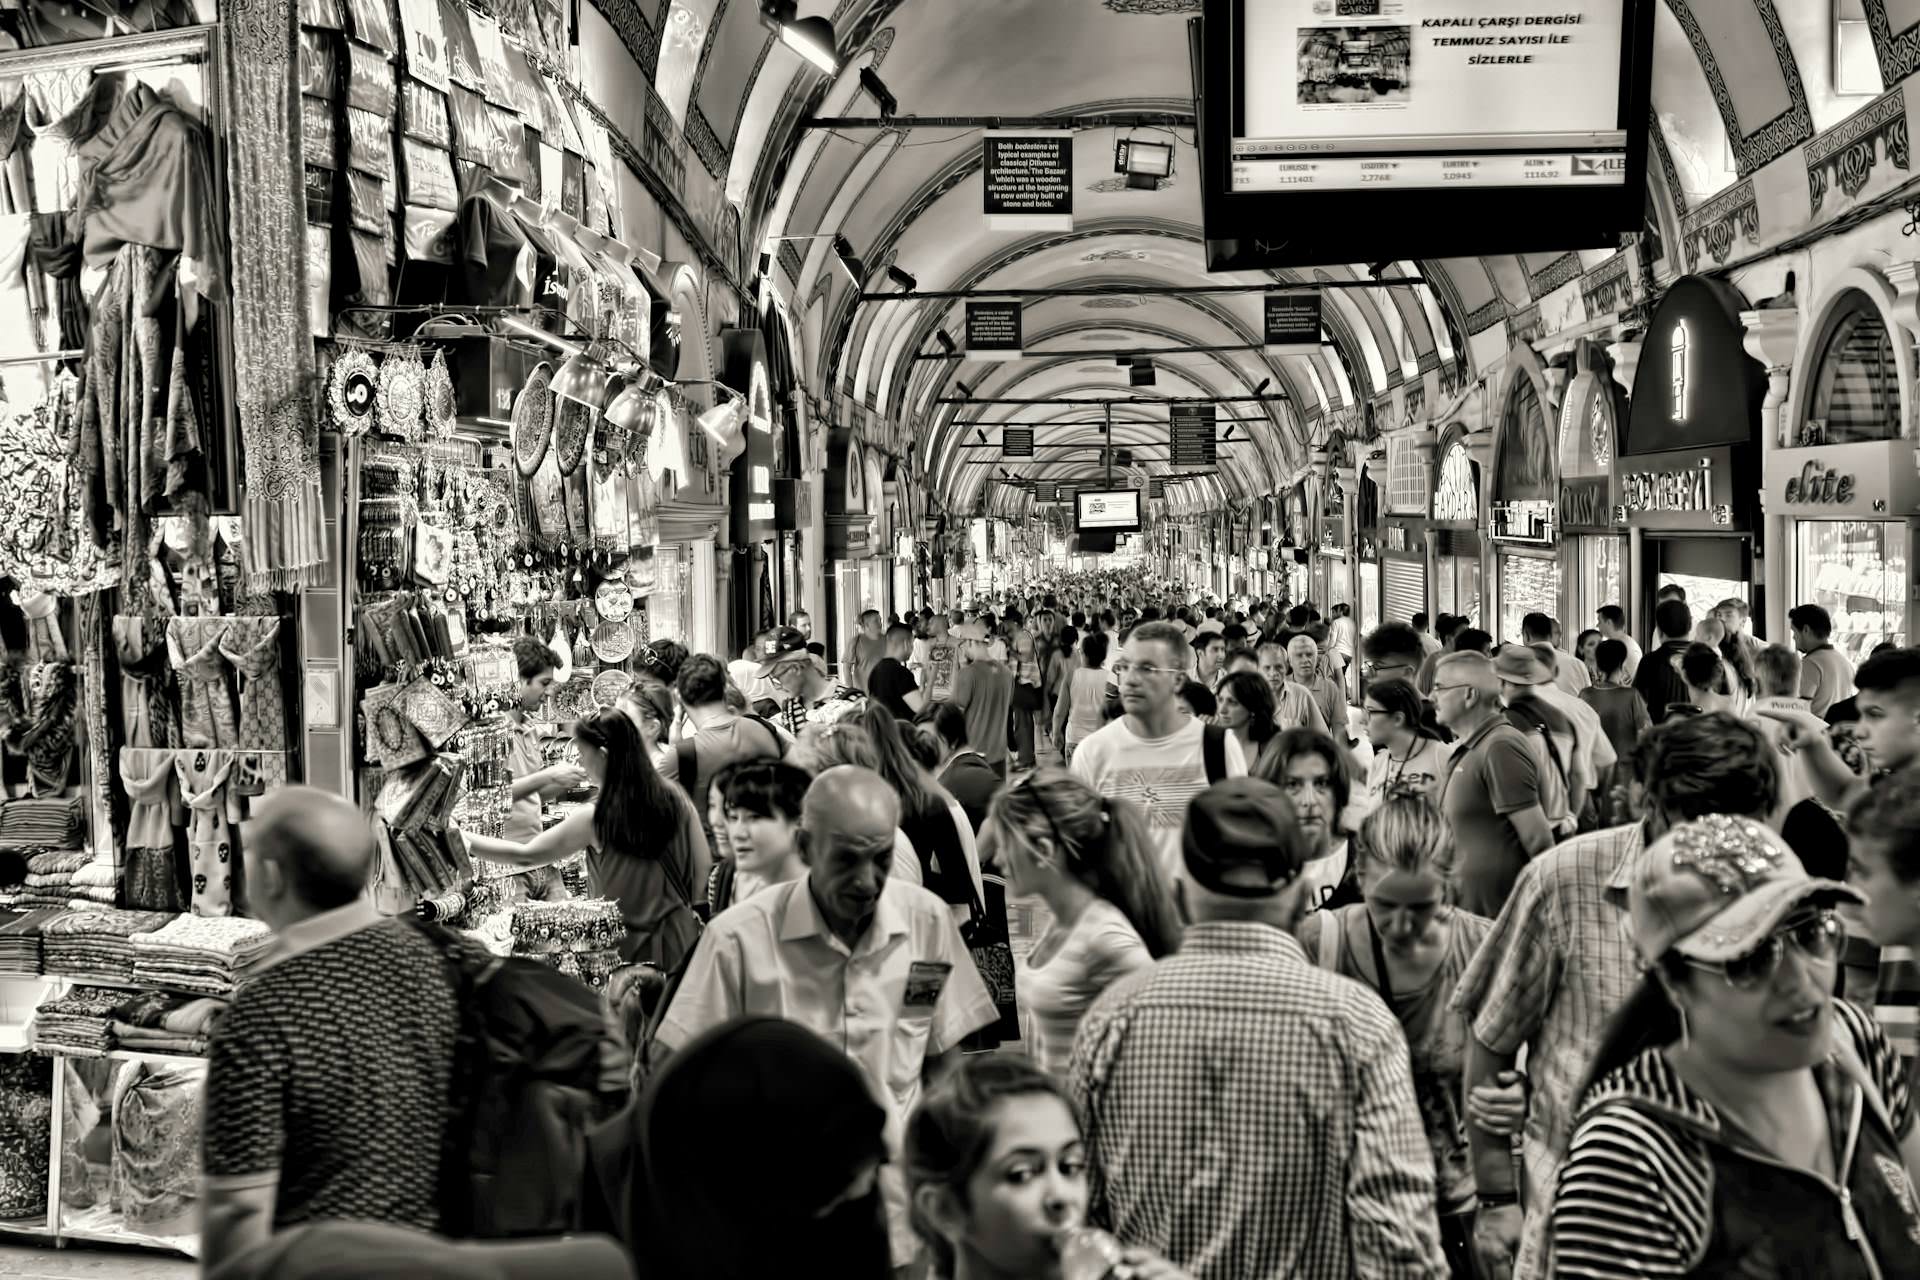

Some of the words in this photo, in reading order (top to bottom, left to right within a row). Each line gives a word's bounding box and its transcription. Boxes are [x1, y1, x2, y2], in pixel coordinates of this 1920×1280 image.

[1421, 18, 1473, 28] KAPALI
[1478, 17, 1520, 28] ÇARŞI
[1524, 13, 1582, 25] DERGİSİ
[1432, 37, 1494, 46] TEMMUZ
[1498, 35, 1543, 45] SAYISI
[1548, 33, 1571, 44] İLE
[1468, 54, 1533, 65] SİZLERLE
[998, 142, 1013, 150] Both
[998, 151, 1019, 159] typical
[1020, 151, 1050, 159] examples
[1037, 184, 1069, 192] beginning
[1016, 192, 1039, 200] entirely
[1785, 460, 1856, 503] elite
